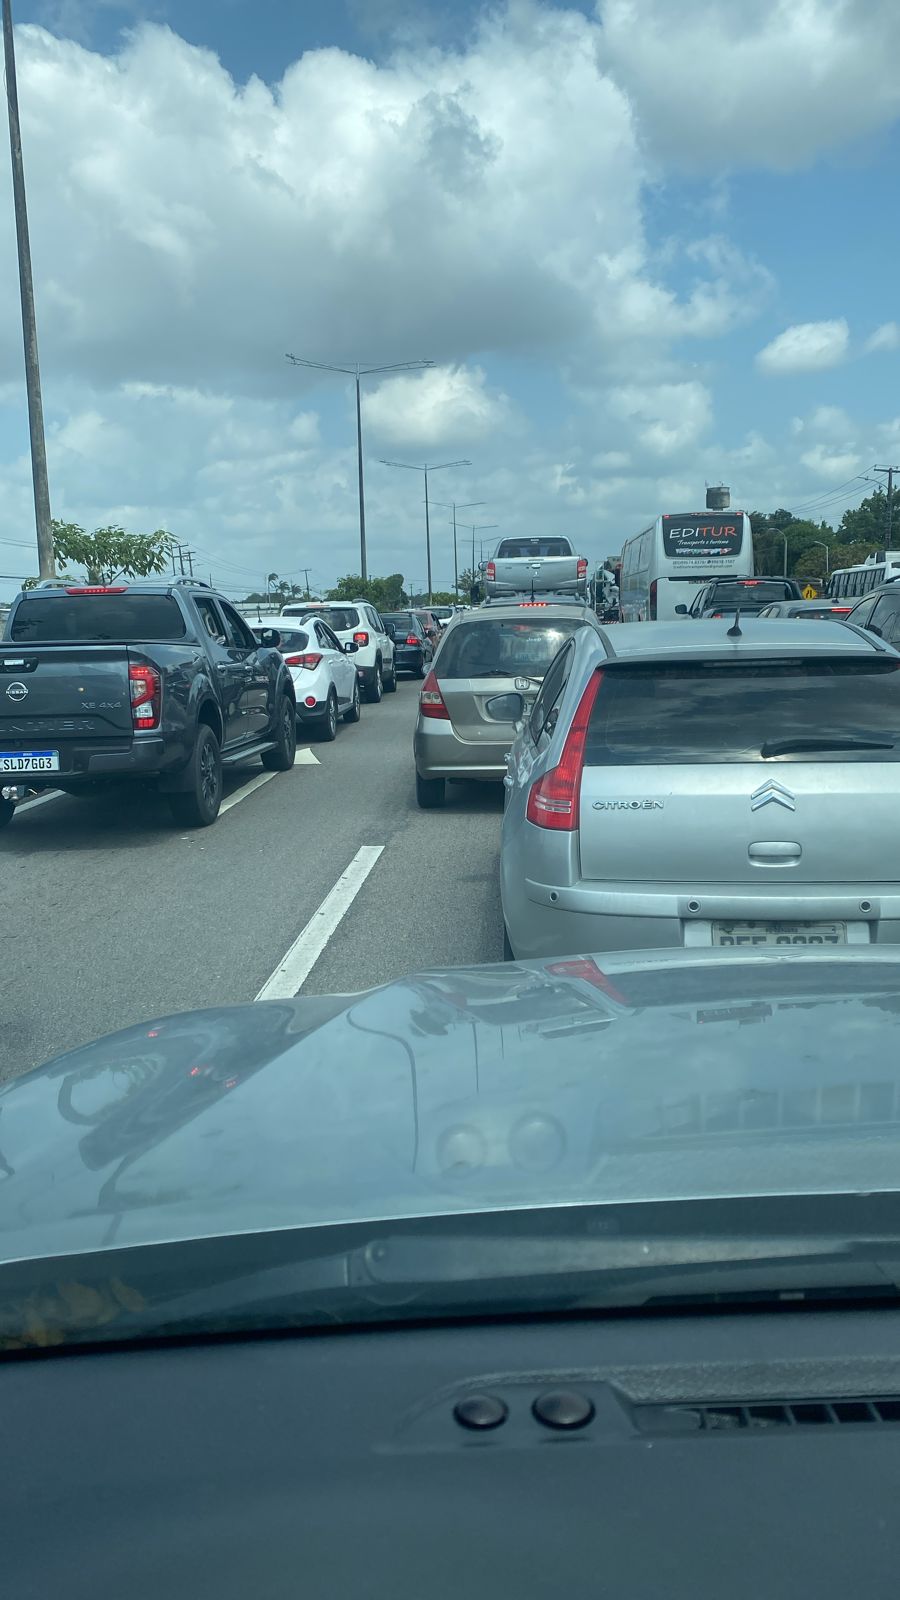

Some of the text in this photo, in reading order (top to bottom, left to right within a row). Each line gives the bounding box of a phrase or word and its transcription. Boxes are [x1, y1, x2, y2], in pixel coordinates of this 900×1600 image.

[669, 526, 738, 539] EDITUR
[3, 758, 52, 770] SLD7G03
[592, 800, 664, 810] CITROËN
